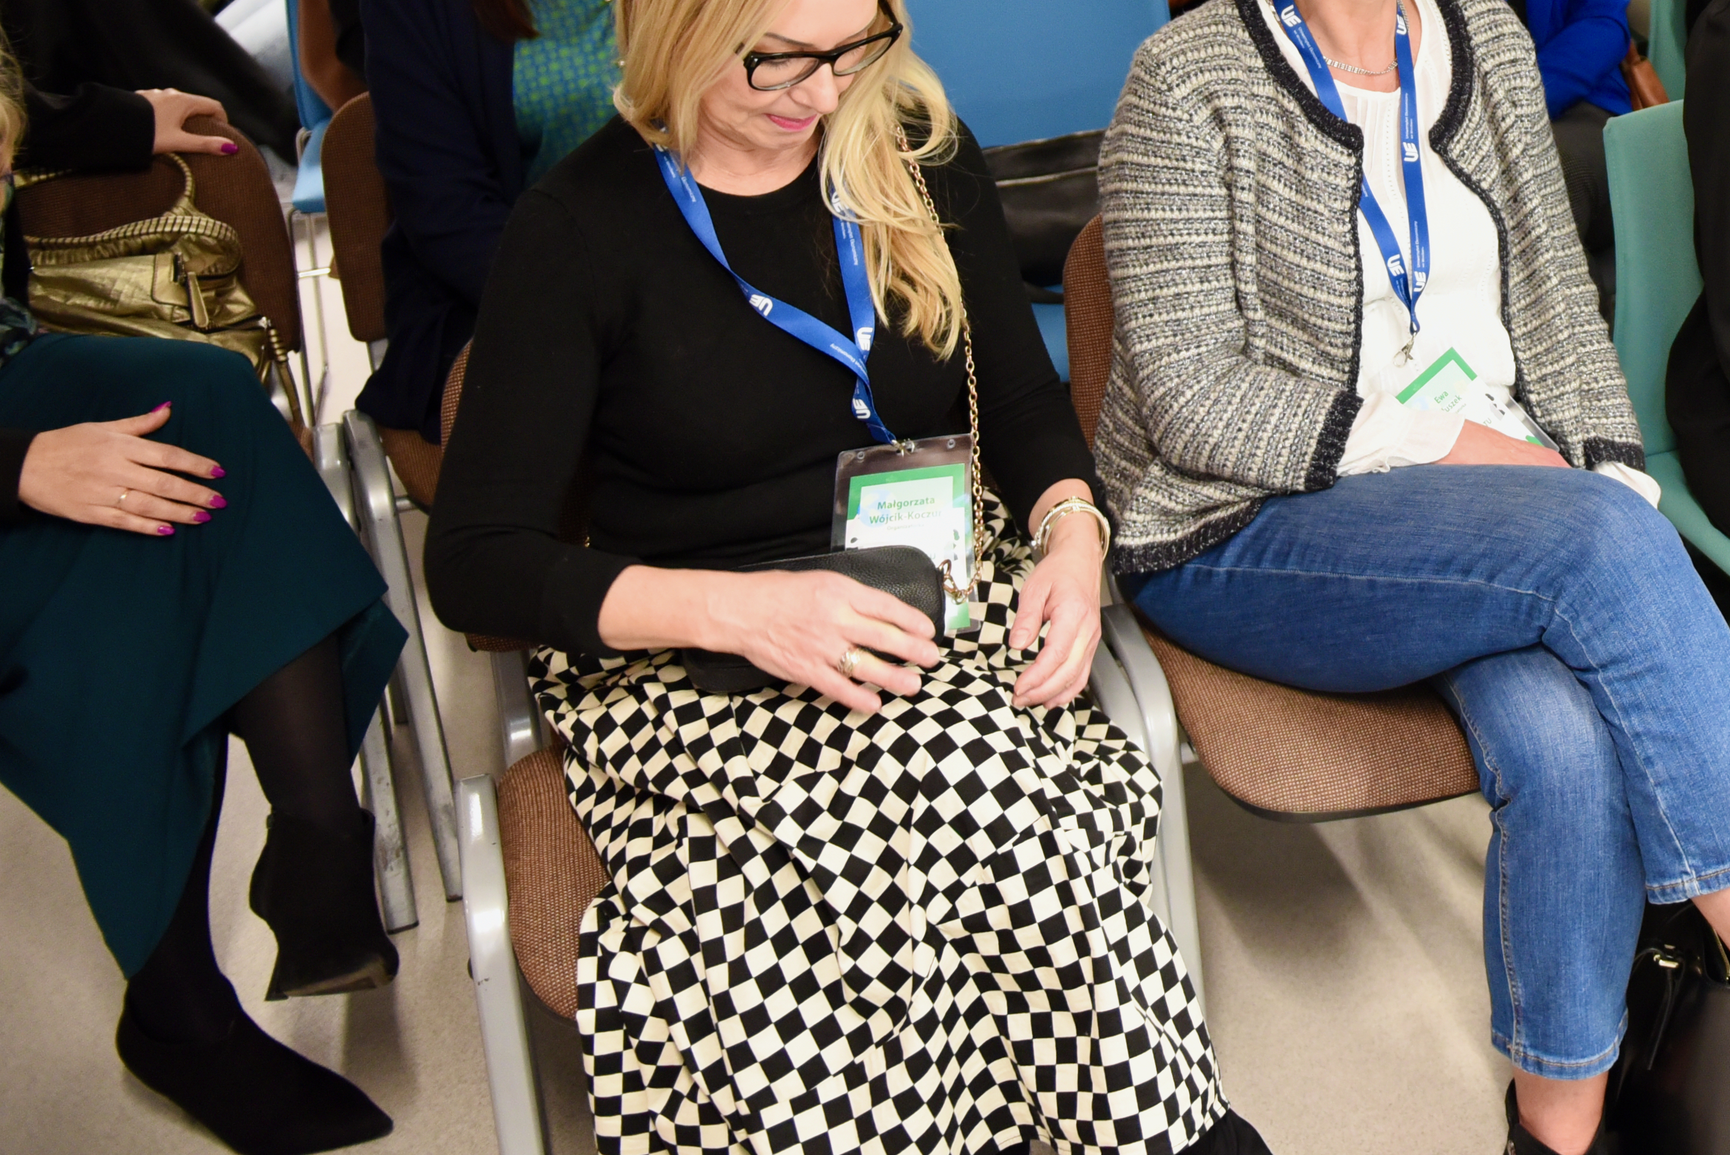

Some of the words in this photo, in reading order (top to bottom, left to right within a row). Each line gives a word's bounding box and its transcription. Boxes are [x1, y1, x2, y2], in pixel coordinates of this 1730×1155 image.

[1281, 5, 1302, 27] UE
[1403, 141, 1420, 162] UE
[1387, 254, 1405, 277] UE
[1414, 271, 1426, 292] UE
[749, 294, 773, 317] UE
[857, 327, 873, 351] UE
[1433, 391, 1449, 404] Ewa
[1441, 396, 1463, 412] uszek
[852, 398, 871, 419] UE
[877, 497, 935, 510] Małgorzata
